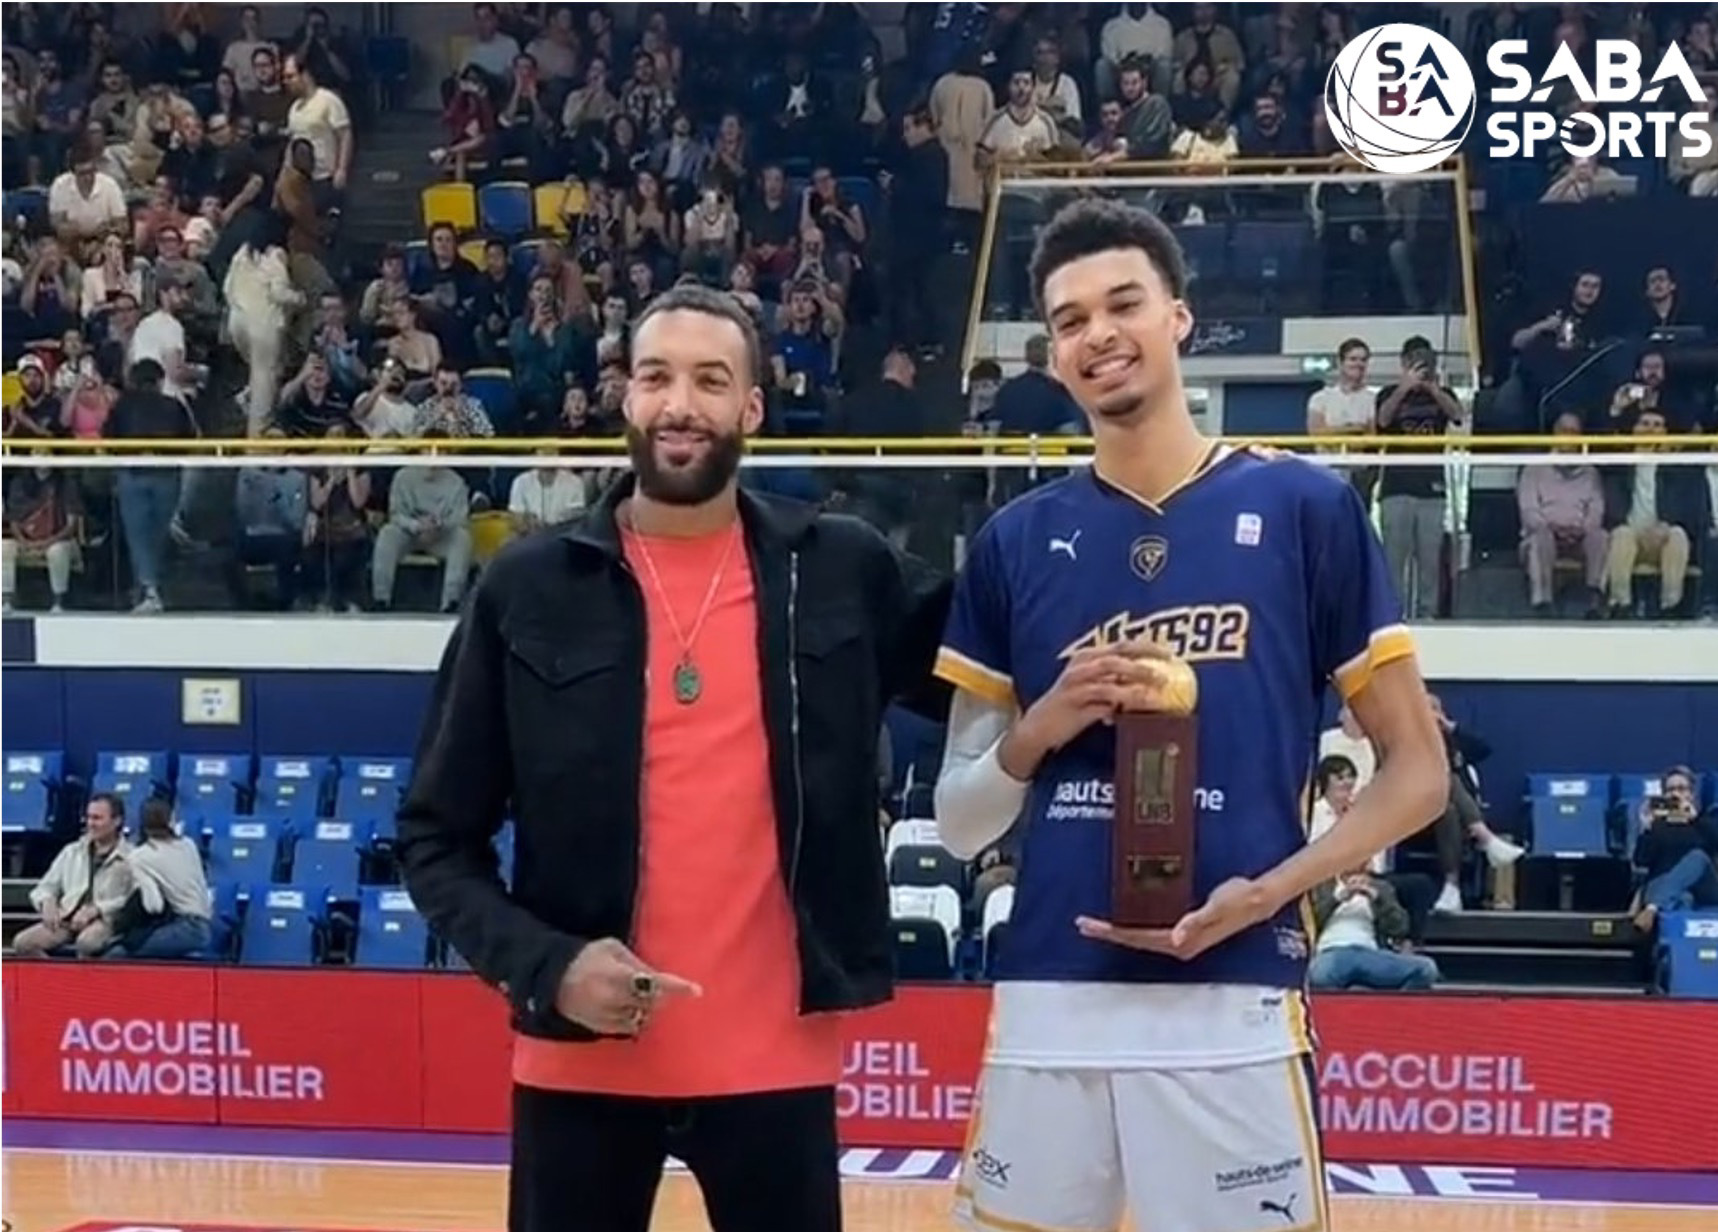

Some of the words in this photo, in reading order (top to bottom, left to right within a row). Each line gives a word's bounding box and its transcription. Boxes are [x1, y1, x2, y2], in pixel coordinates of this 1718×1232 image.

[60, 1018, 252, 1057] ACCUEIL
[843, 1040, 930, 1076] UEIL
[1319, 1052, 1535, 1092] ACCUEIL
[61, 1059, 324, 1100] IMMOBILIER
[835, 1083, 973, 1119] OBILIE
[1319, 1094, 1614, 1139] IMMOBILIER
